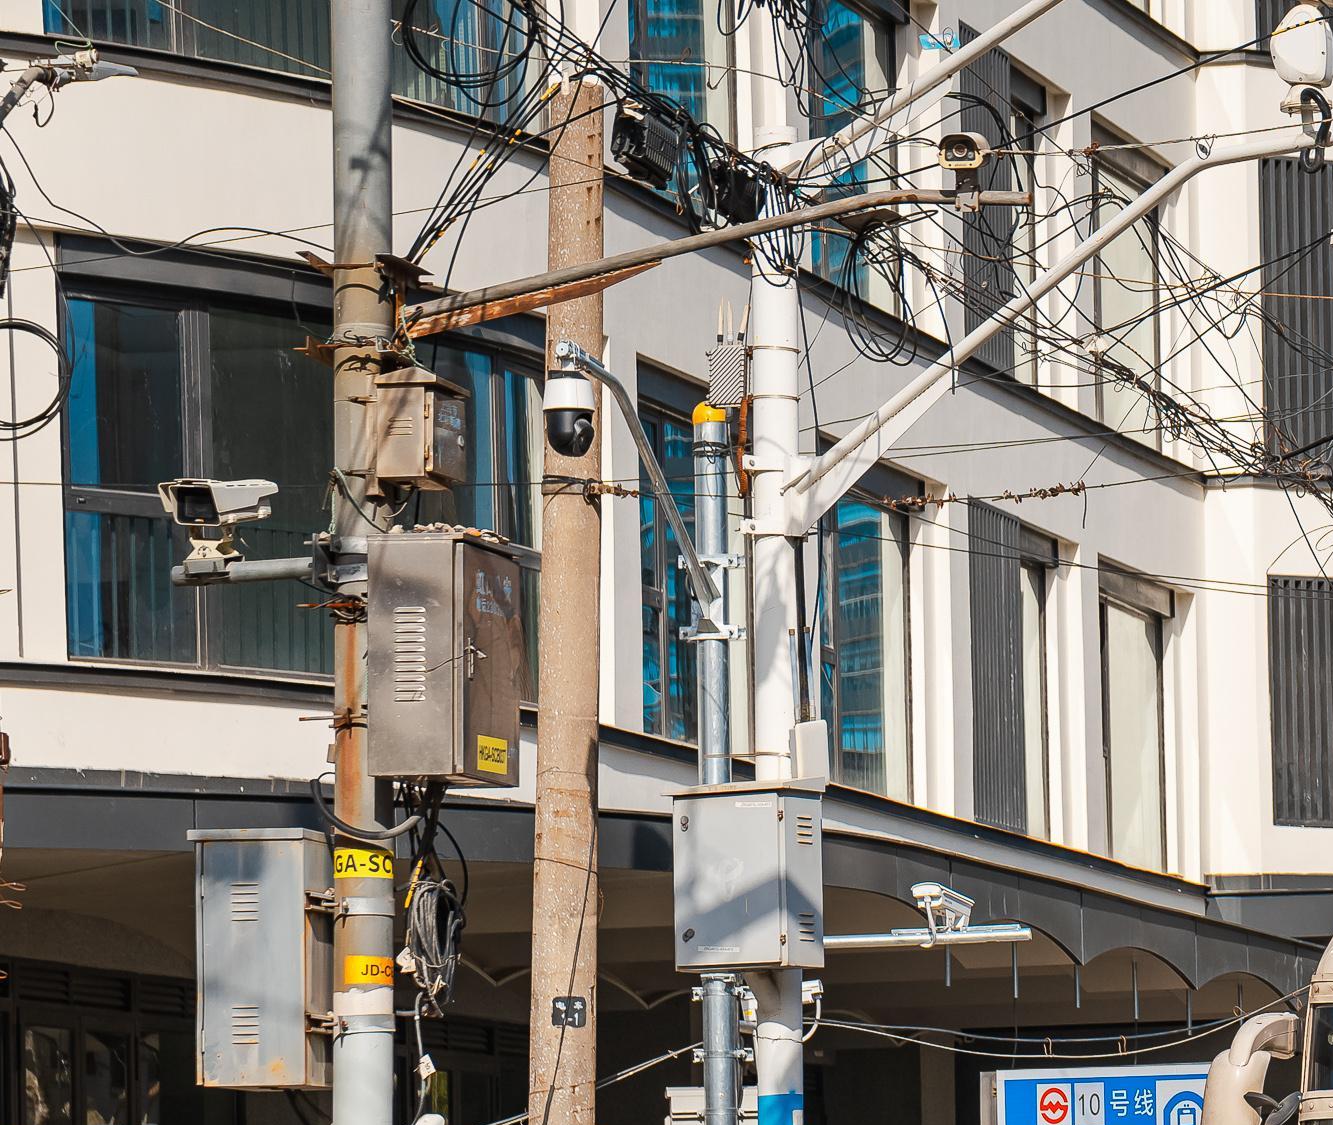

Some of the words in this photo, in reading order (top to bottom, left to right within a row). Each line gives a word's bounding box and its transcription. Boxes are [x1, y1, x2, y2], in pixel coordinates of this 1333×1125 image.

[361, 964, 393, 978] JD-C
[1078, 1092, 1101, 1116] 10
[1109, 1088, 1154, 1117] 号线
